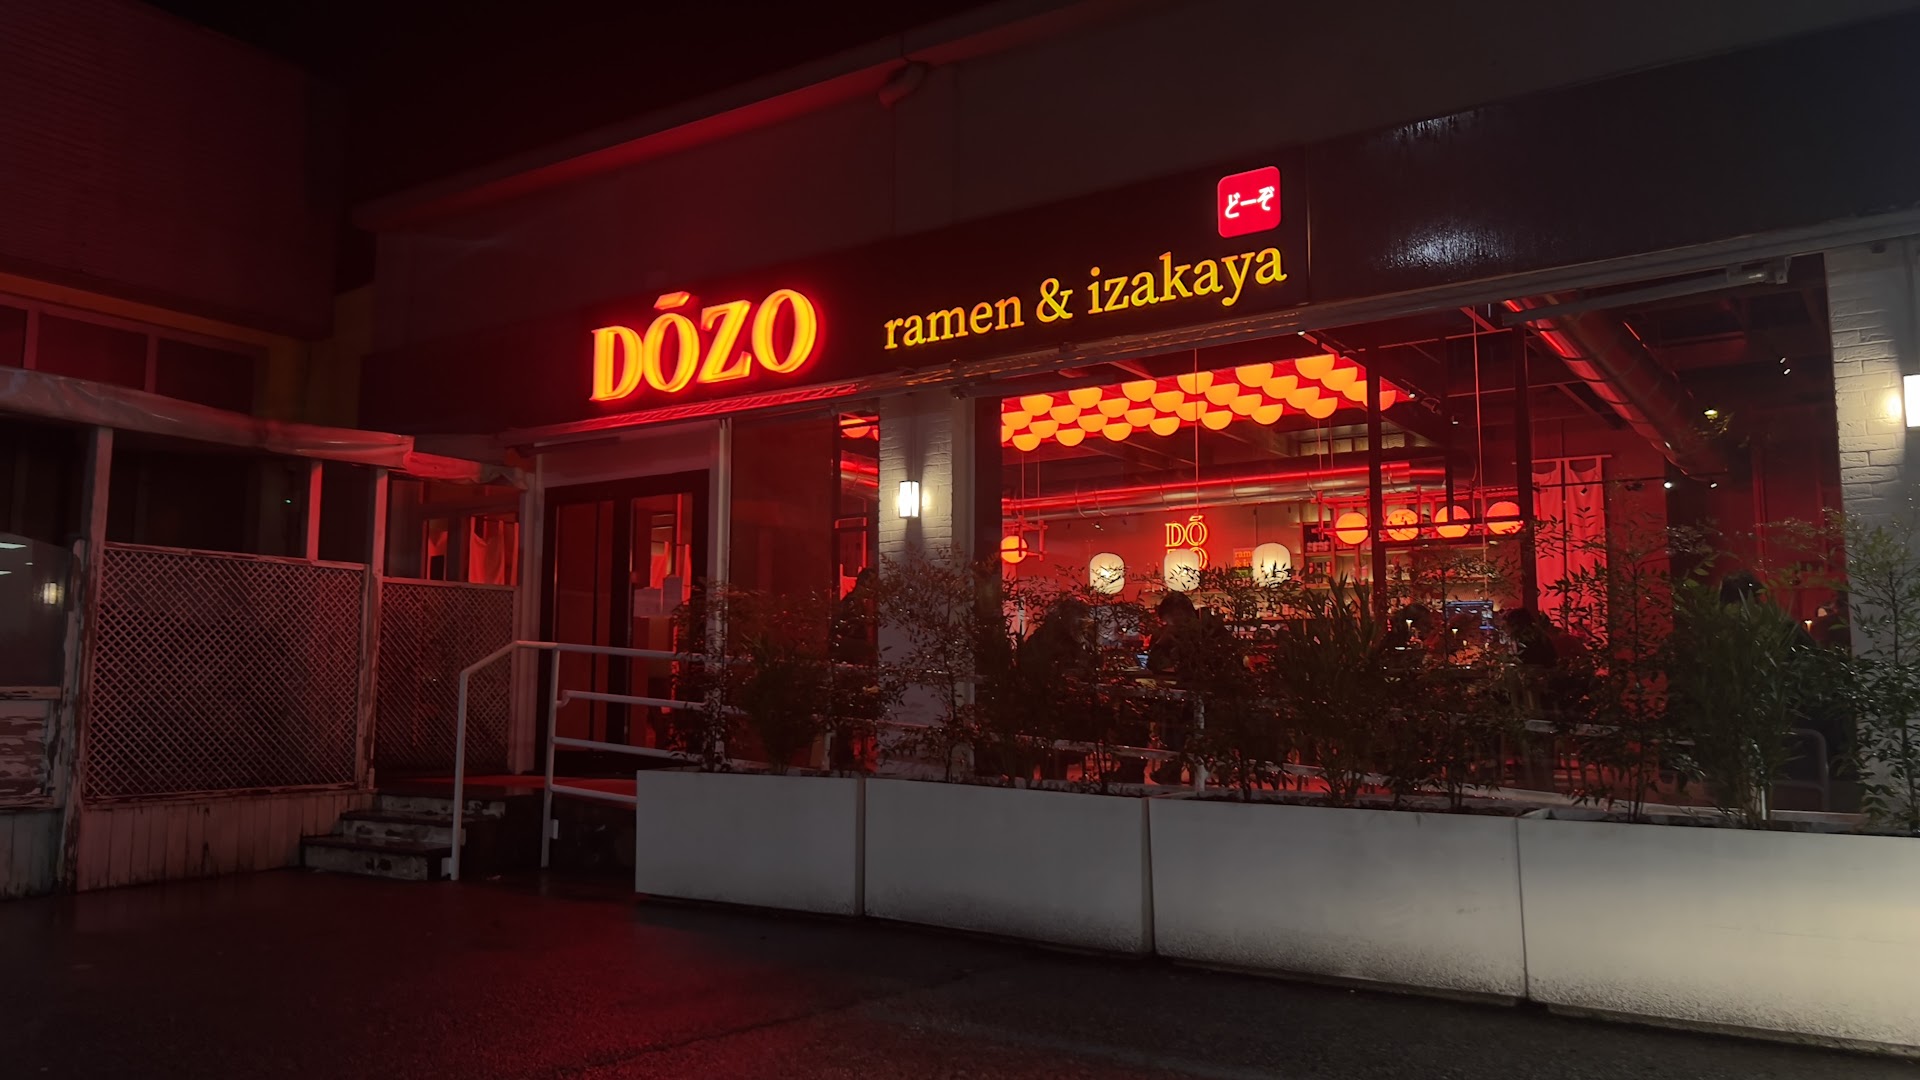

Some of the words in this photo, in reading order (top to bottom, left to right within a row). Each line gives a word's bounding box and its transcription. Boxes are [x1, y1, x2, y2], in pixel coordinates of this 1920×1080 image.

[1224, 186, 1275, 219] どーぞ
[592, 288, 818, 402] DŌZO
[884, 296, 1024, 350] ramen
[1036, 278, 1074, 323] &
[1088, 247, 1288, 309] izakaya
